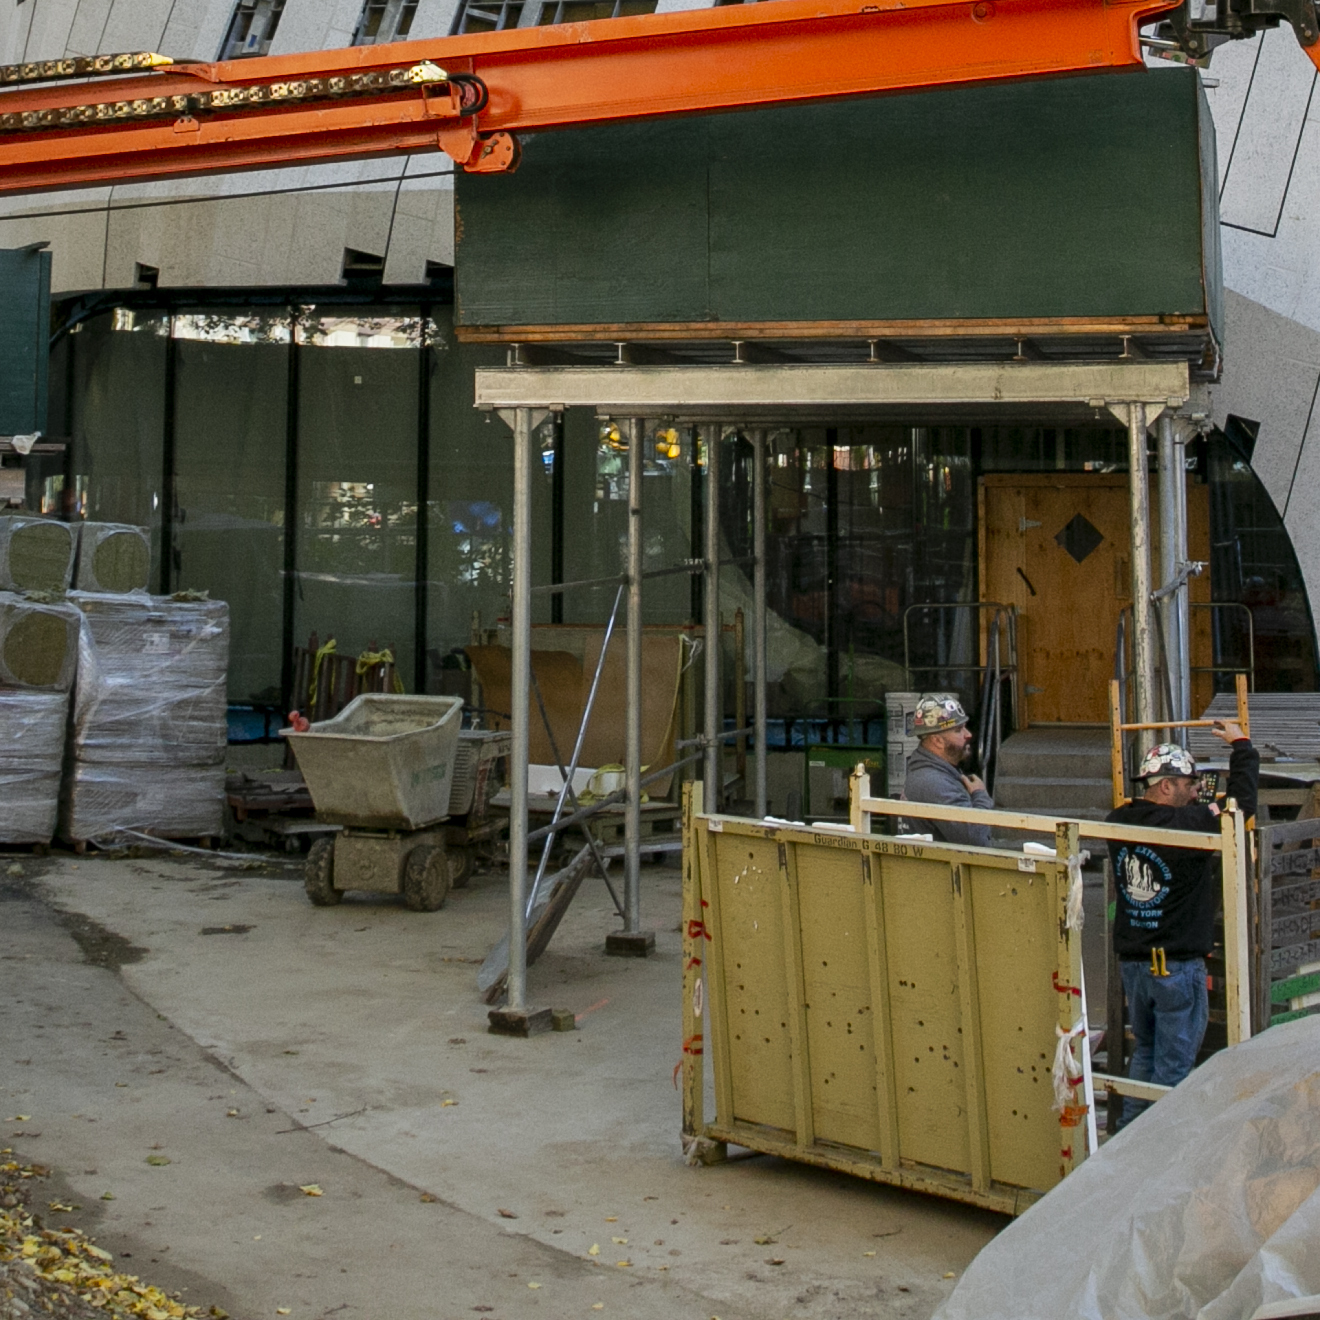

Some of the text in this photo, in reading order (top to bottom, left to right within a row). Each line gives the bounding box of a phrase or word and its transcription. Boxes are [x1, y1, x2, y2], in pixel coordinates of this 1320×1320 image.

[814, 833, 857, 848] Guardian
[874, 842, 888, 853] 48
[913, 845, 924, 857] W
[1135, 846, 1172, 880] EXTERIOR
